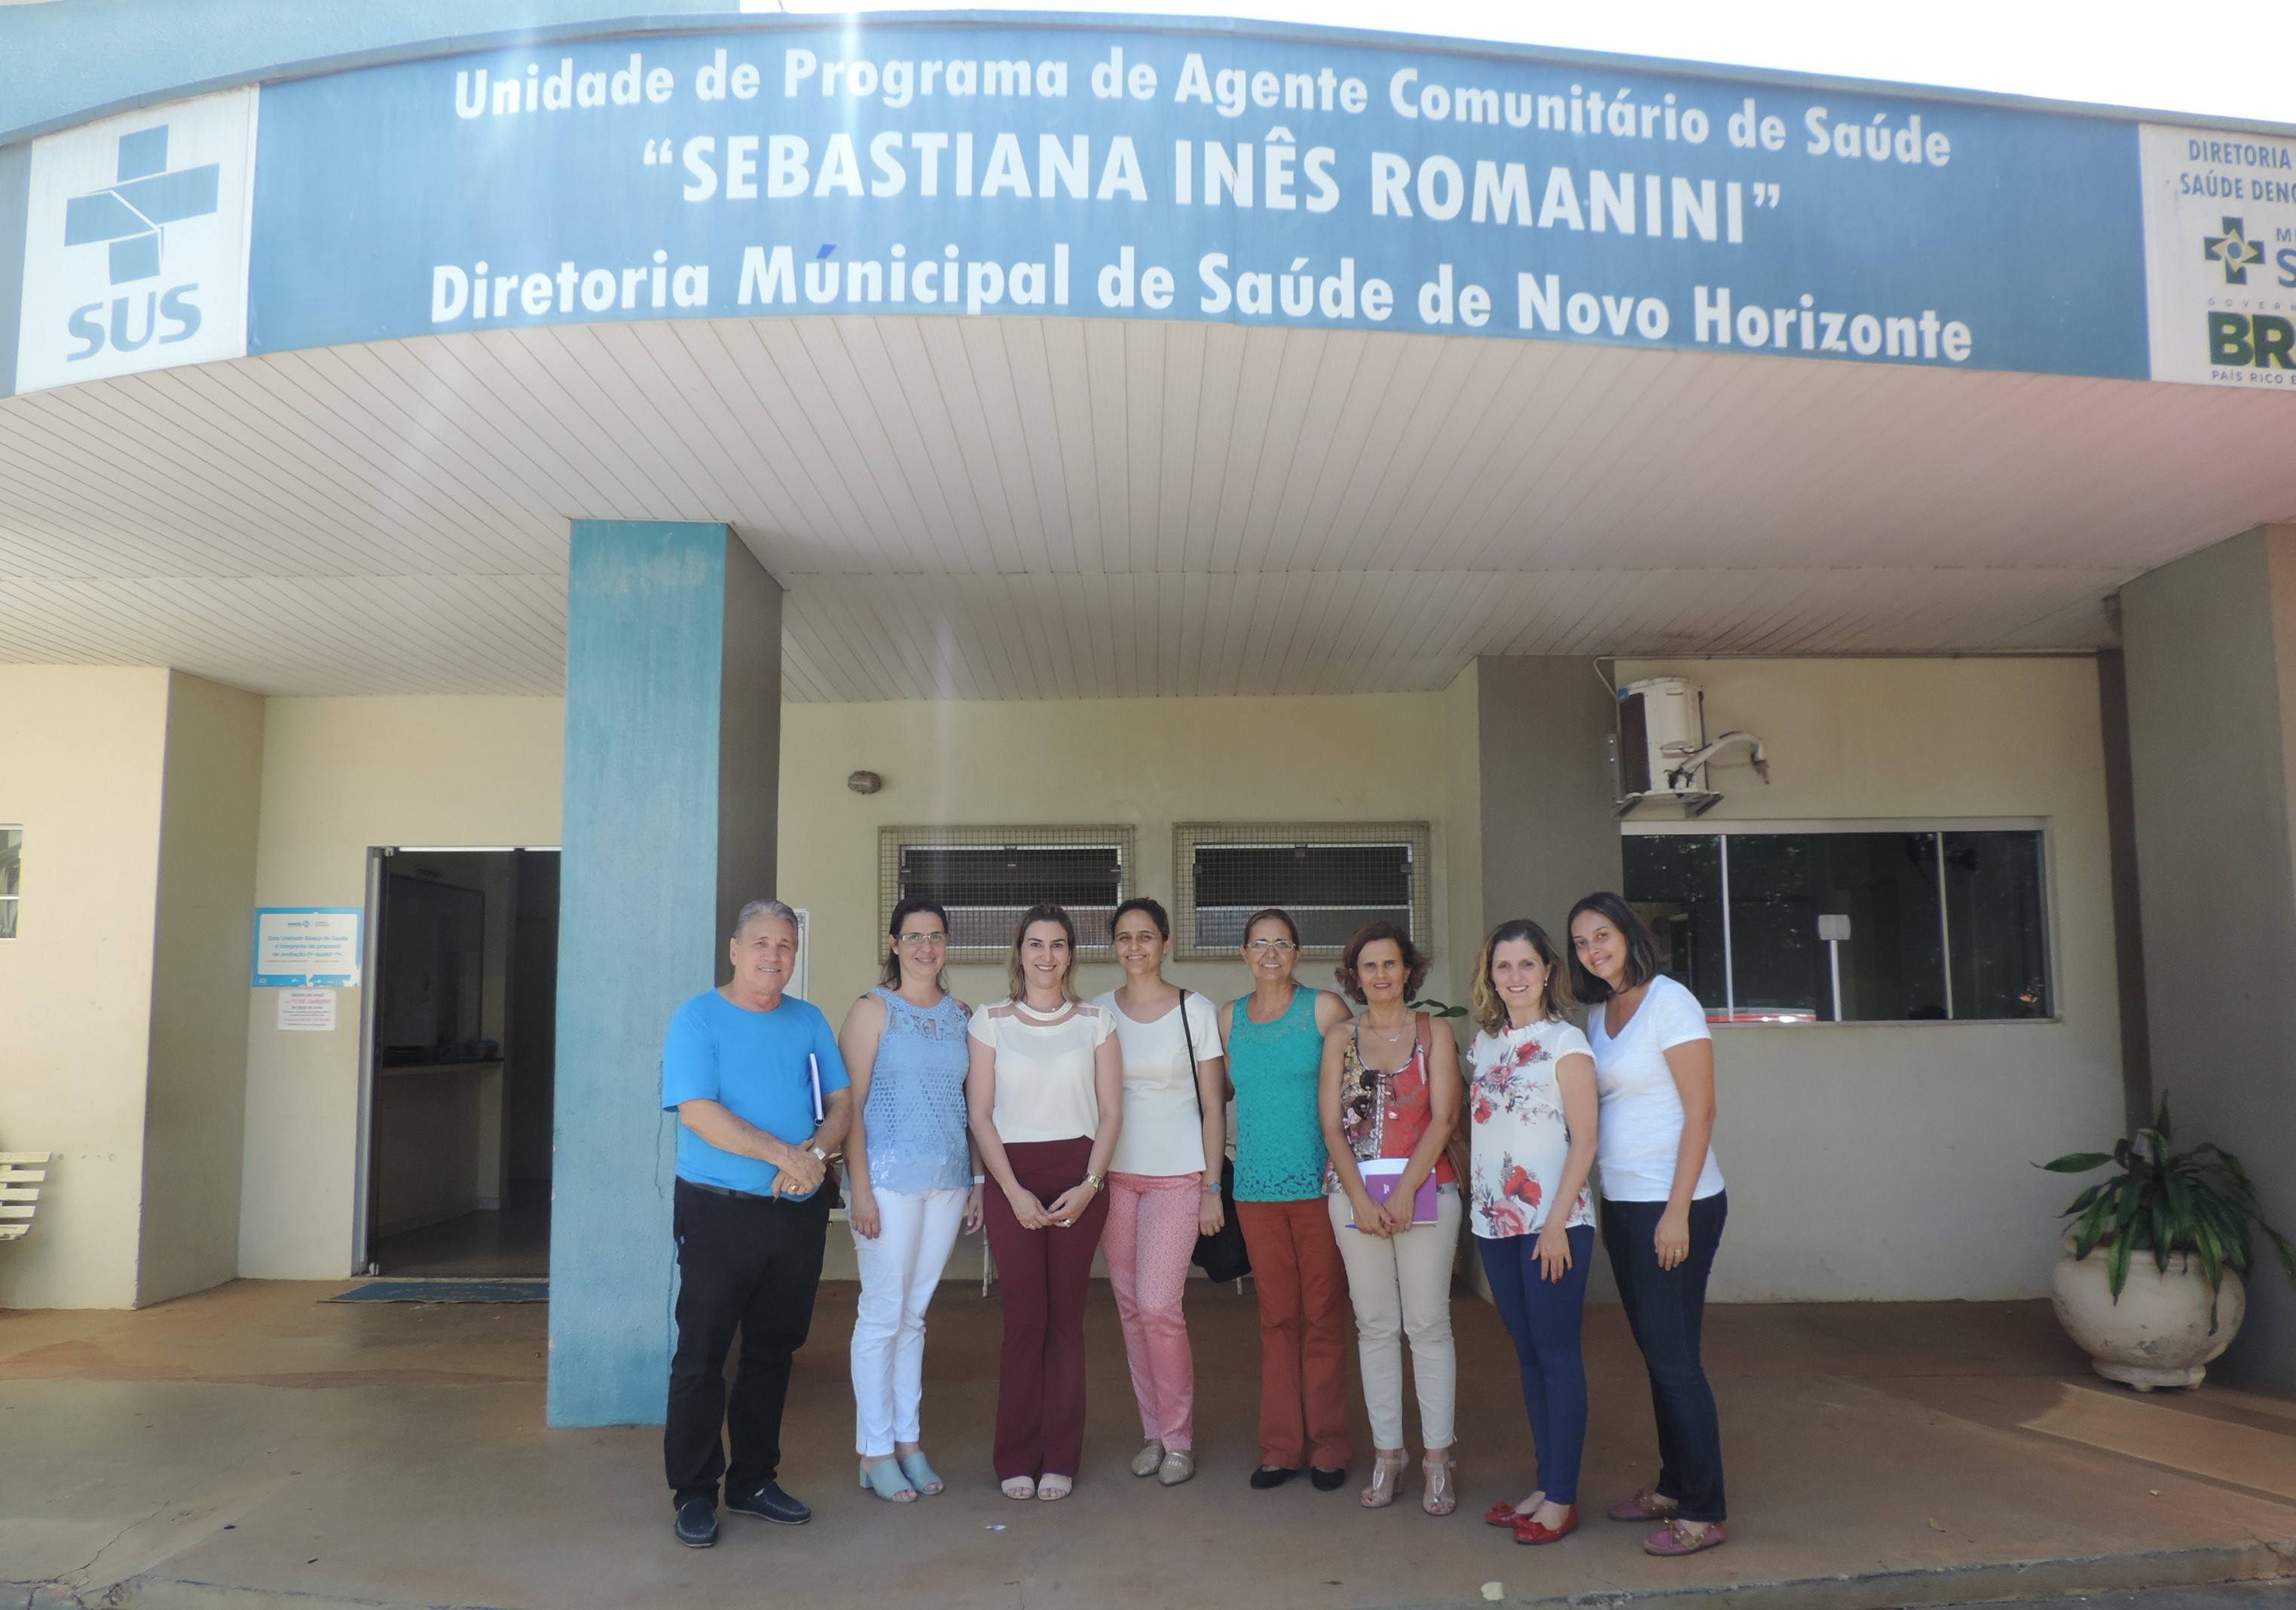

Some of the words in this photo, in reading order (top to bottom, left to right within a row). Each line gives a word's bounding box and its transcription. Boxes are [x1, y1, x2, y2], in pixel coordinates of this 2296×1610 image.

[455, 53, 674, 120] Unidade
[695, 49, 760, 101] de
[784, 49, 1068, 108] Programa
[1091, 47, 1157, 101] de
[1174, 53, 1368, 118] Agente
[1389, 68, 1710, 145] Comunitário
[1727, 99, 1787, 151] de
[1805, 107, 1951, 167] Saúde
[644, 132, 1148, 202] “SEBASTIANA
[1175, 127, 1340, 213] INÊS
[1371, 151, 1781, 243] ROMANINI”
[2180, 169, 2244, 199] SAÚDE
[2188, 139, 2292, 170] DIRETORIA
[67, 283, 202, 362] SUS
[431, 249, 709, 322] Diretoria
[1097, 246, 1175, 310] de
[1198, 252, 1394, 320] Saúde
[1418, 263, 1491, 326] de
[1518, 272, 1670, 339] Novo
[1694, 286, 1972, 361] Horizonte
[2212, 369, 2243, 382] PAÍS
[2250, 372, 2283, 384] RICO
